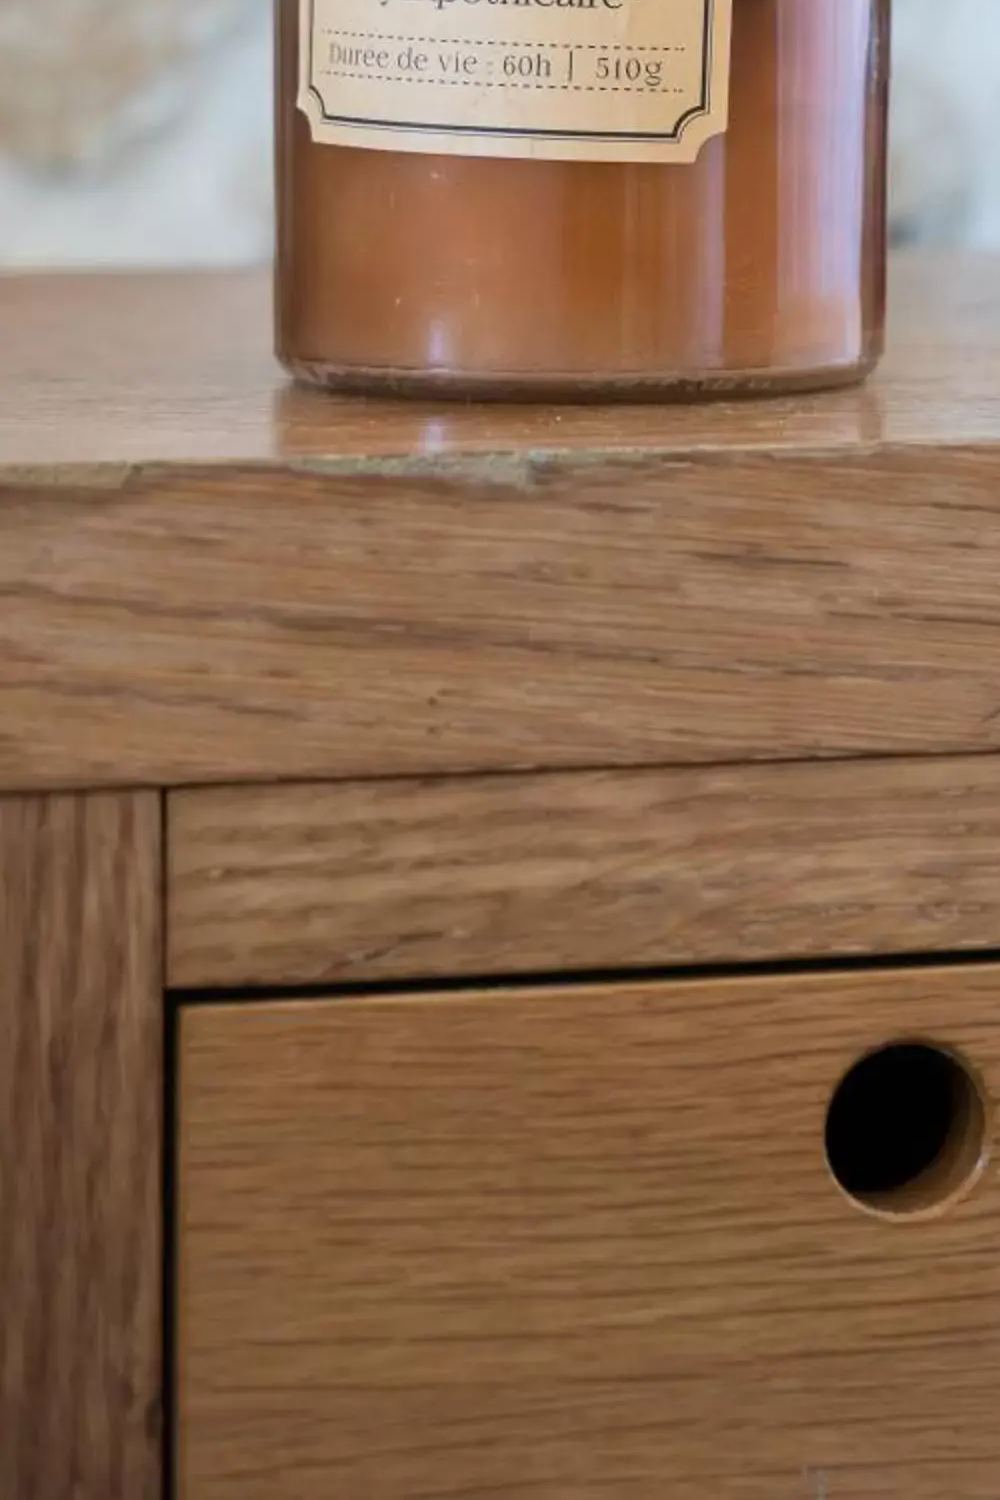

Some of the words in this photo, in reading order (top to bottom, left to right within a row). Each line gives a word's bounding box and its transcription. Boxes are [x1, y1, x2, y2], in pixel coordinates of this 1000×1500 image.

[397, 46, 429, 73] de
[438, 50, 478, 75] vie
[502, 54, 552, 79] 60h
[595, 56, 664, 87] 510g
